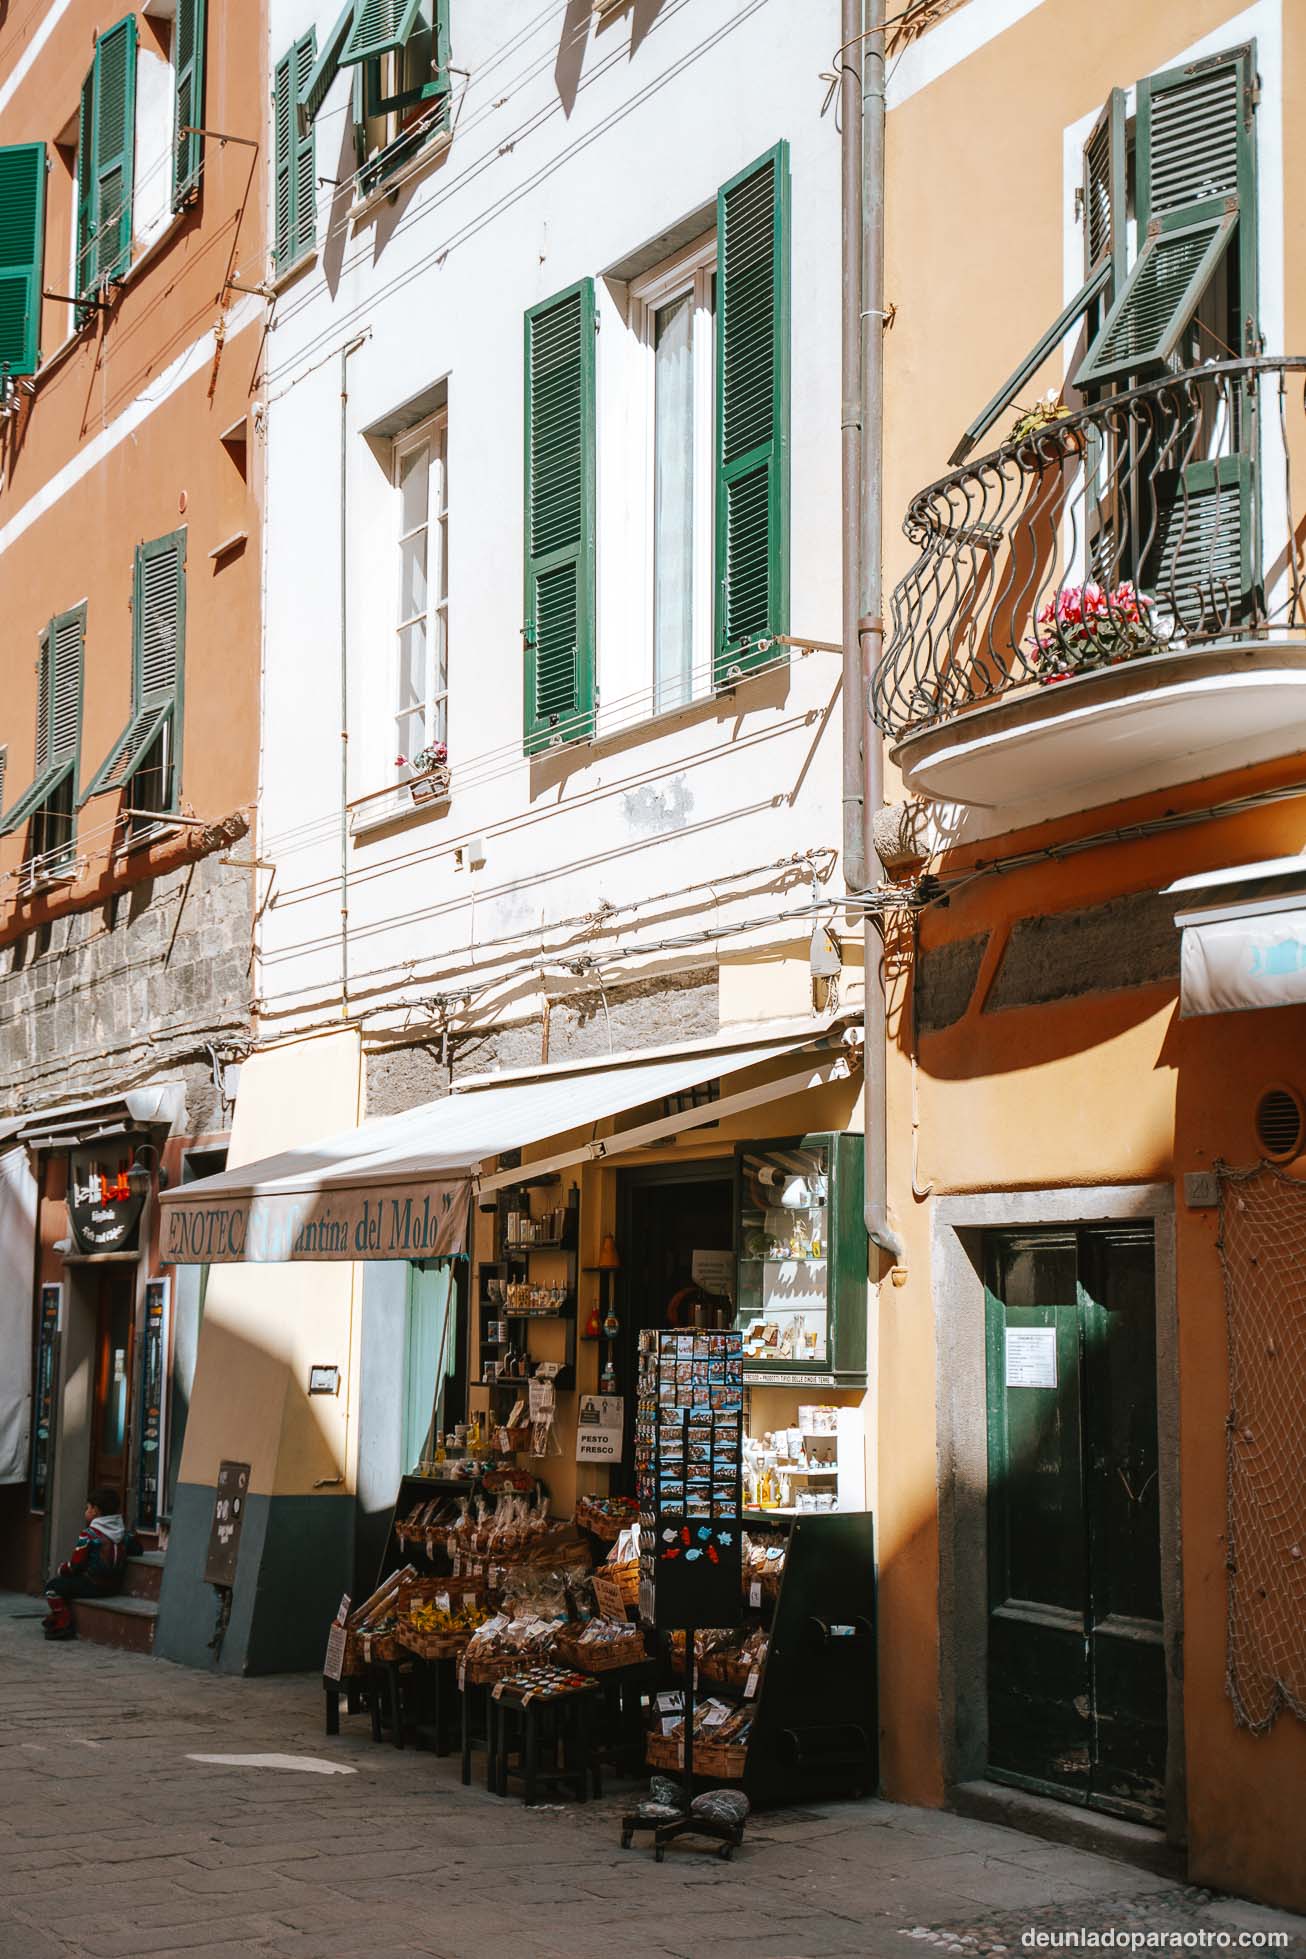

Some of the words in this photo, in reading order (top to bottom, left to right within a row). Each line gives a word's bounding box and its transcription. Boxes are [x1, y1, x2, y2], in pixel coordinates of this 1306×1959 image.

[354, 1199, 383, 1251] del
[581, 1435, 609, 1443] PESTO
[580, 1446, 614, 1454] FRESCO
